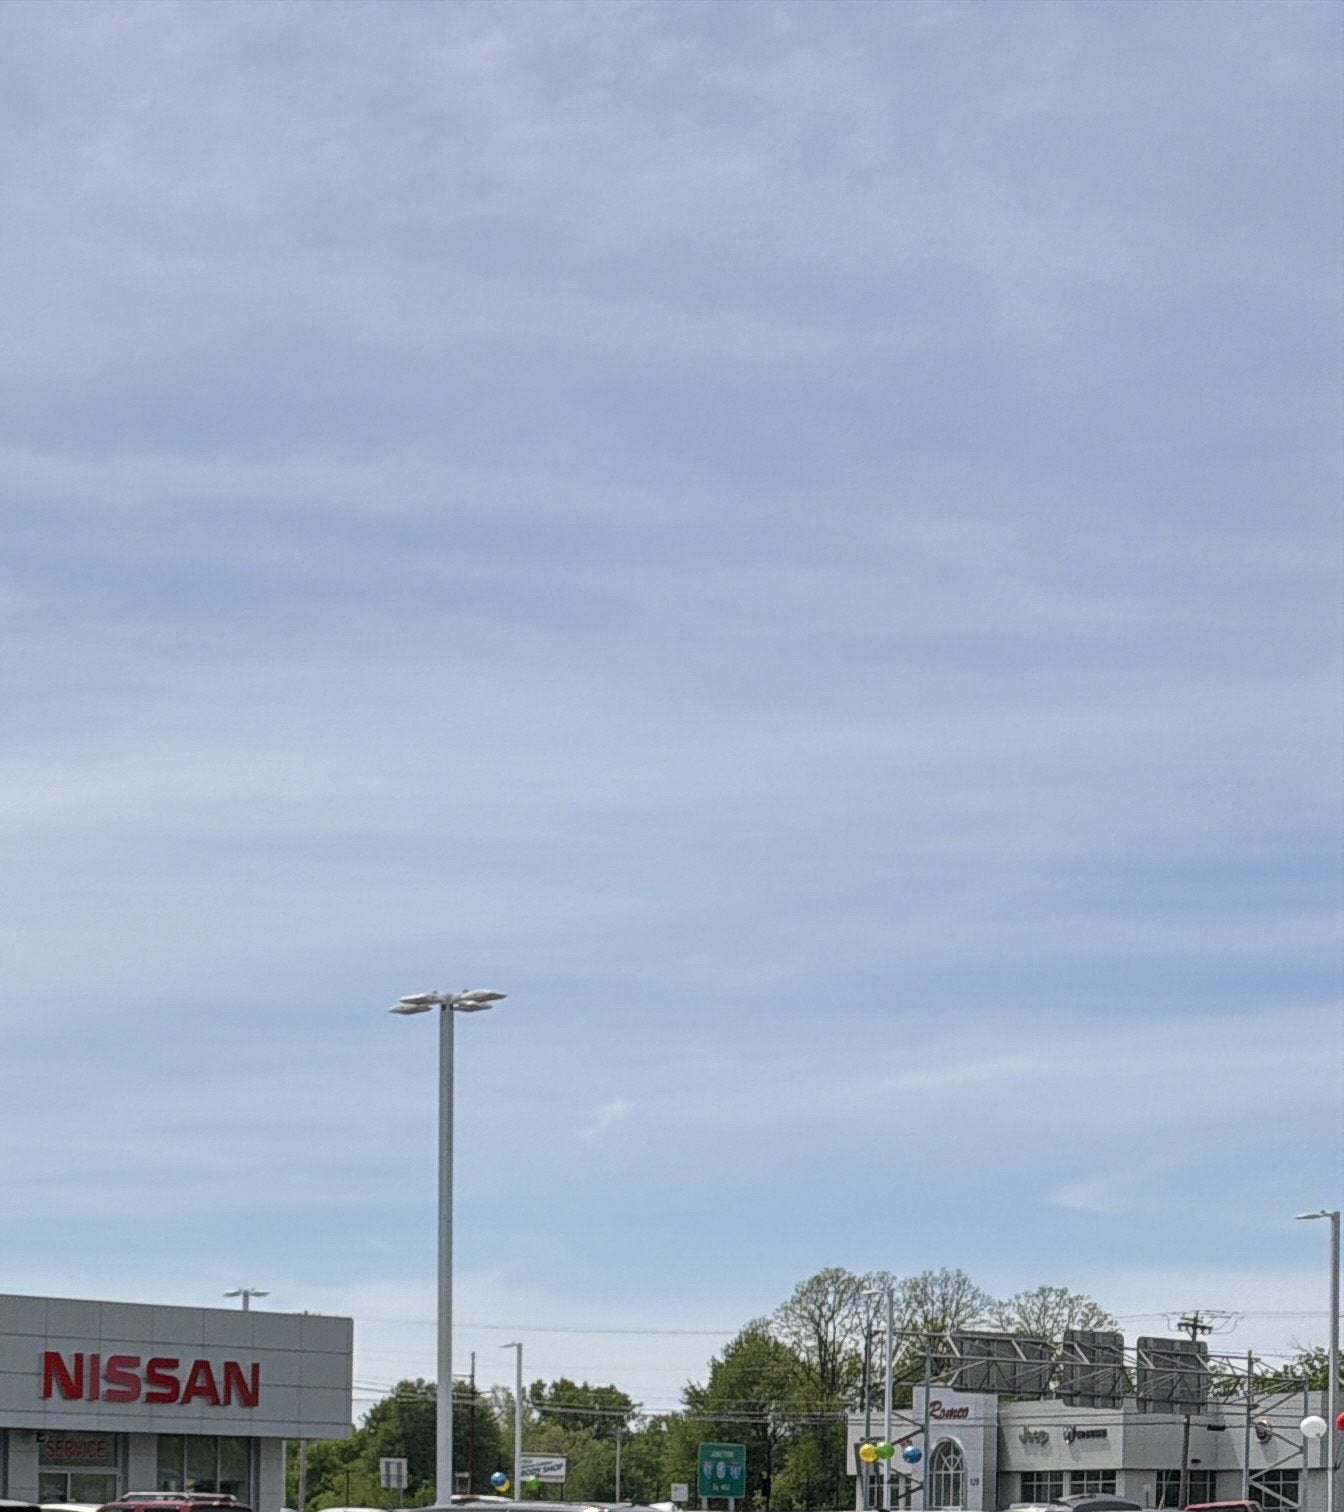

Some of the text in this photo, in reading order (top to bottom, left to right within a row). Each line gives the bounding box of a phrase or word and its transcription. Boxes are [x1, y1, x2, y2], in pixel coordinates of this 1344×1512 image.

[41, 1350, 261, 1408] NISSAN
[929, 1400, 970, 1420] Romeo
[46, 1439, 106, 1459] SERVICE
[542, 1462, 564, 1473] SHOP
